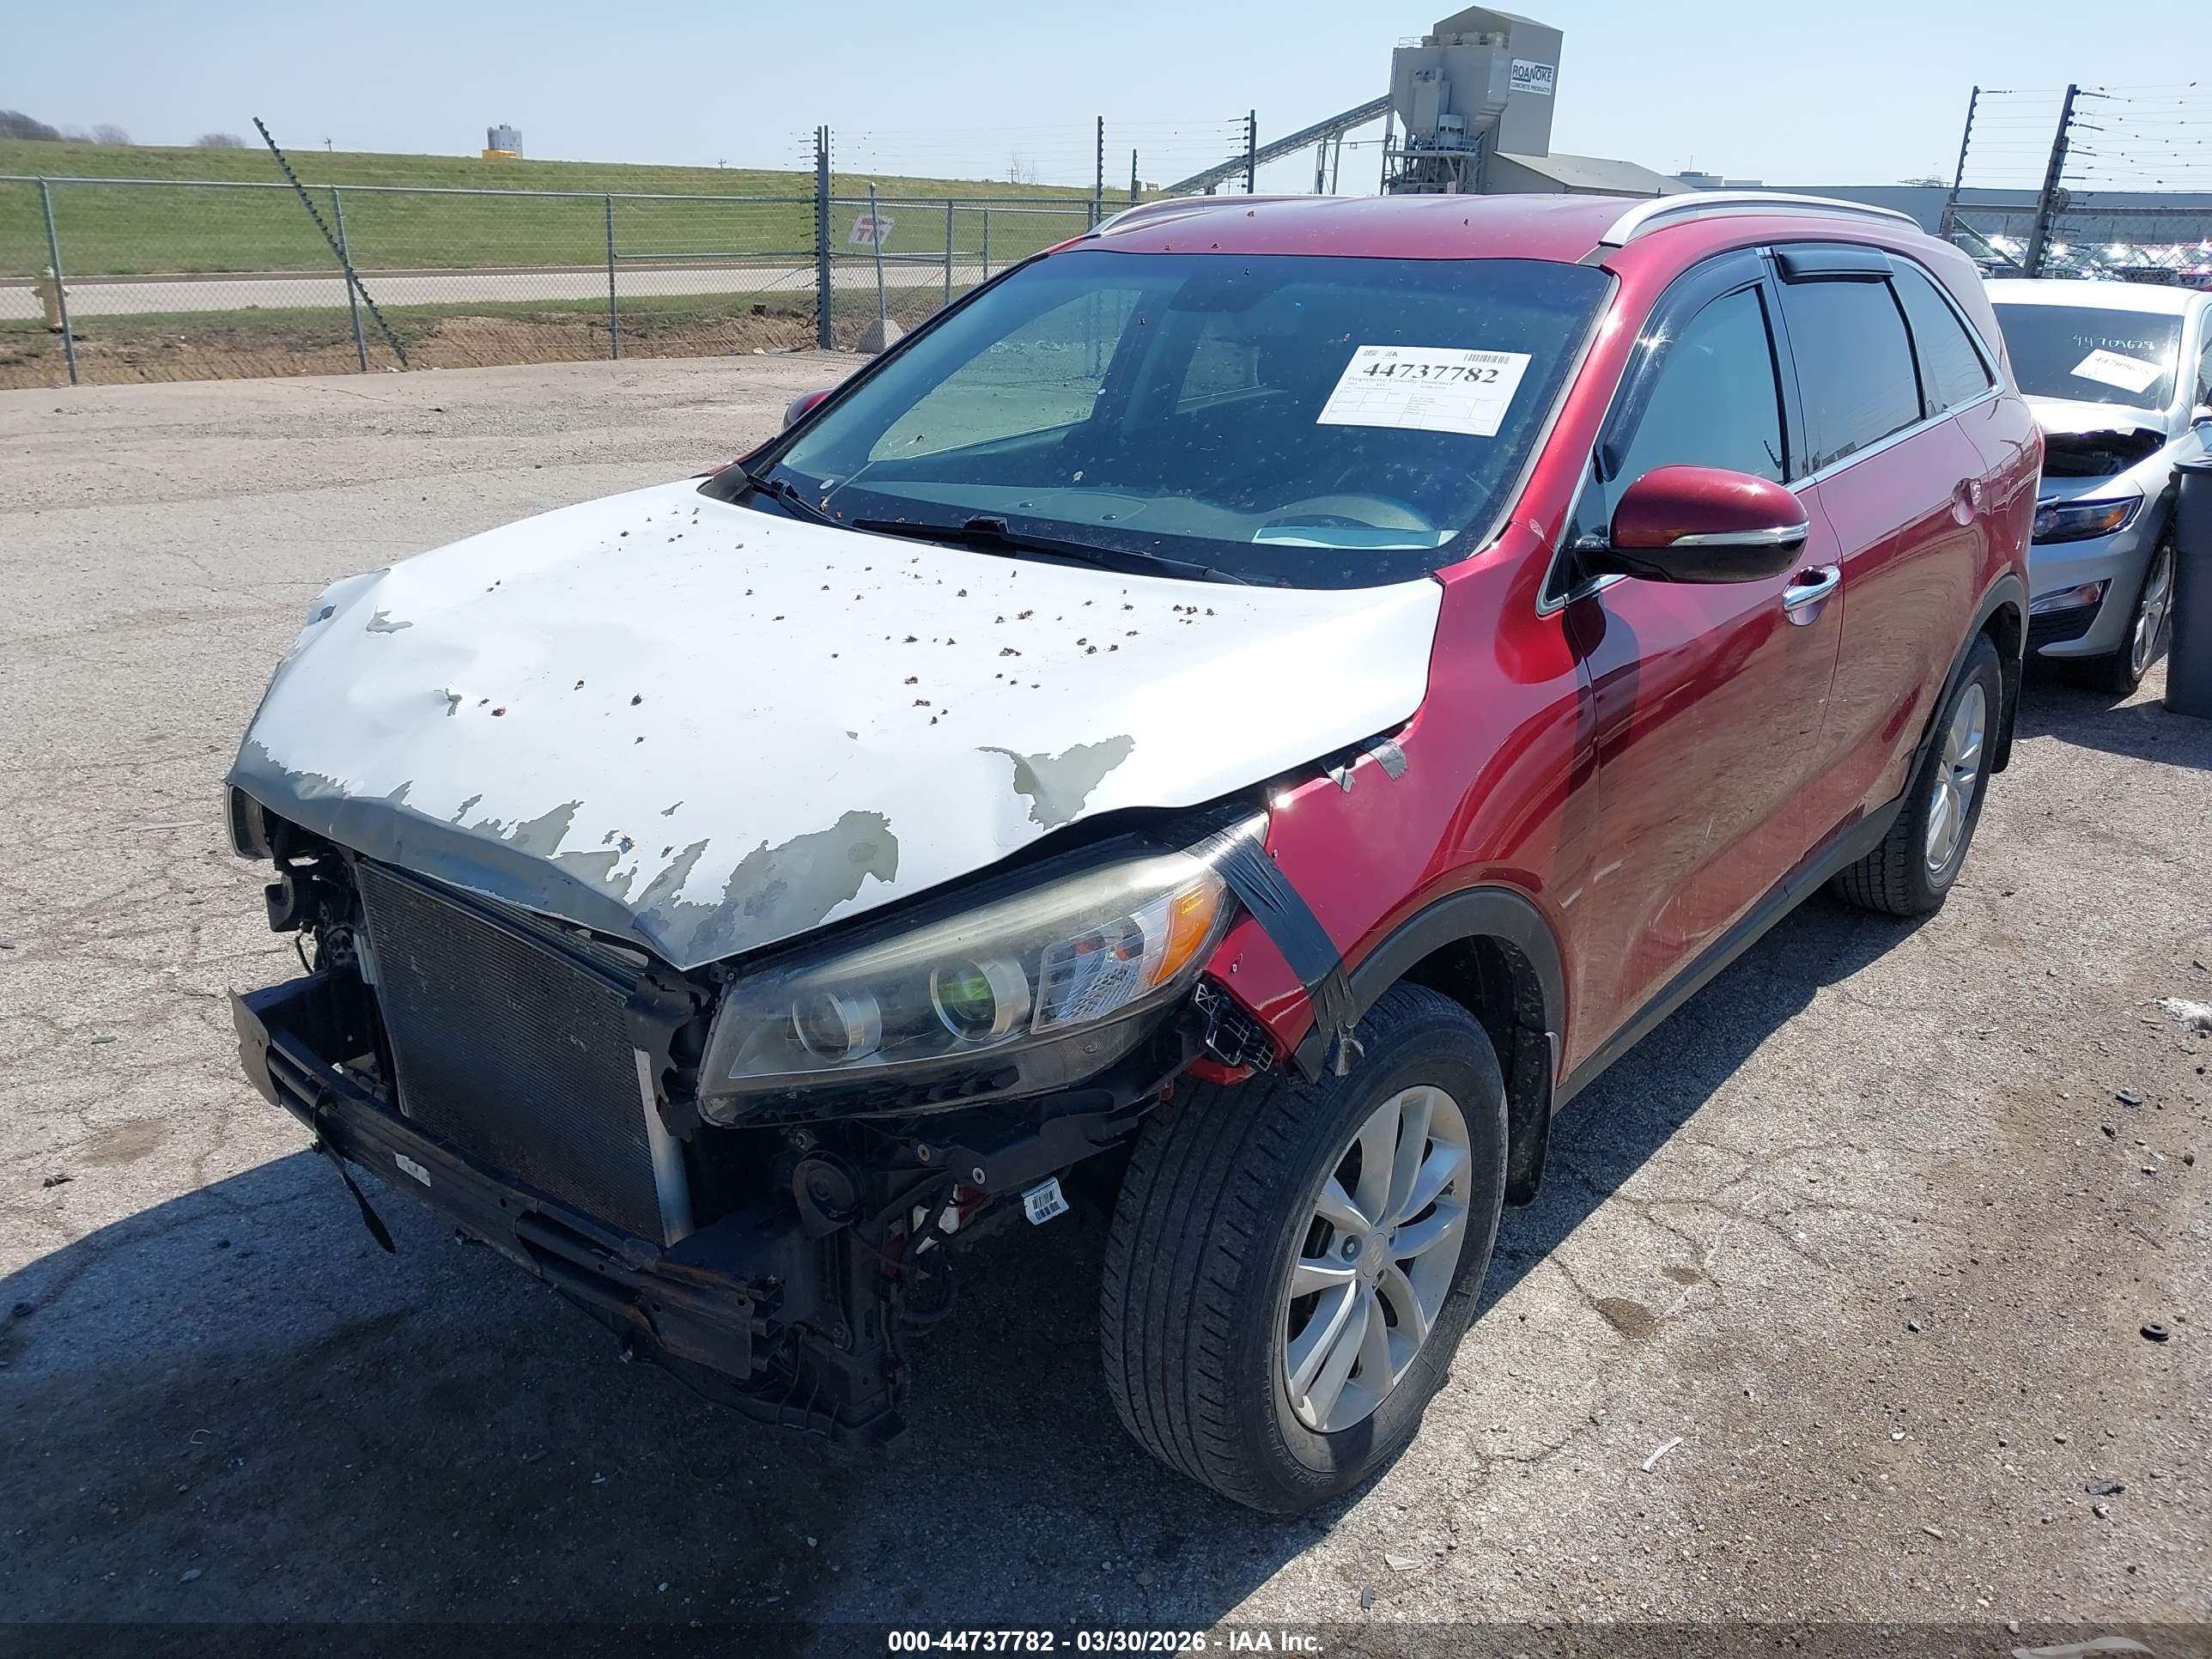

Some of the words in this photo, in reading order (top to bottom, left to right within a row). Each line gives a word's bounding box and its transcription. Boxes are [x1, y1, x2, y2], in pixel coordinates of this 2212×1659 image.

[1512, 65, 1552, 82] ROANOKE
[2072, 334, 2155, 350] 44709628
[1363, 363, 1499, 384] 44737782
